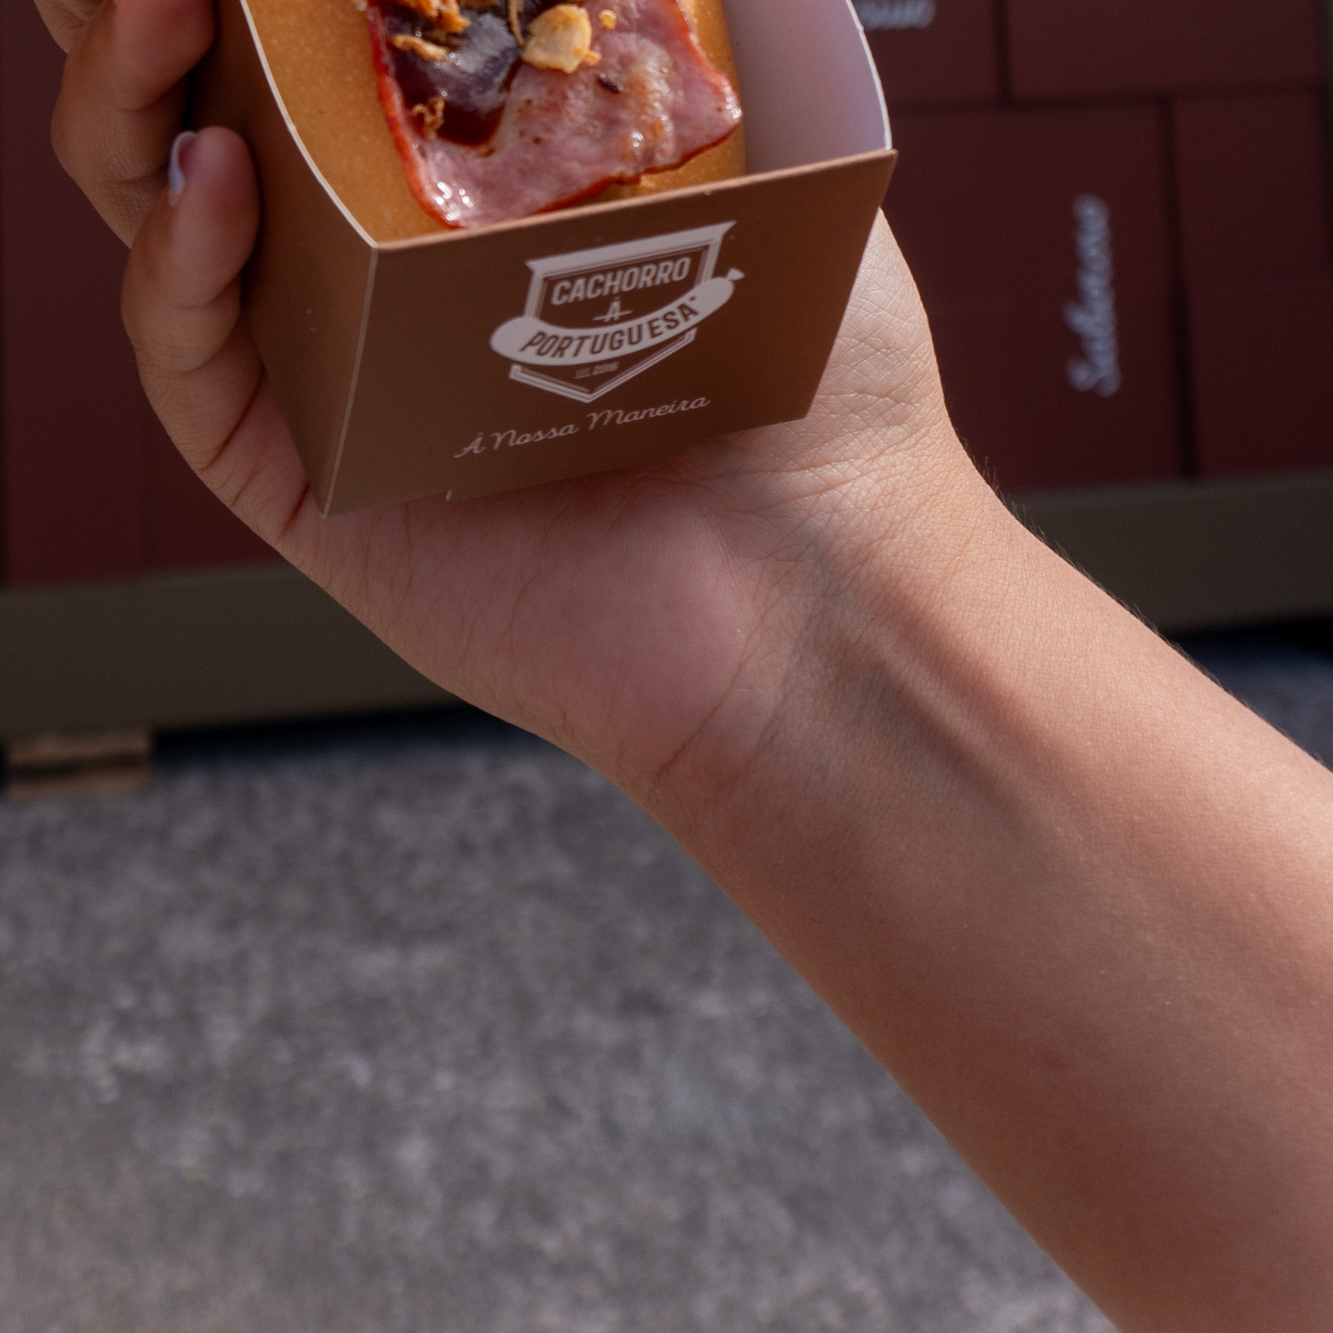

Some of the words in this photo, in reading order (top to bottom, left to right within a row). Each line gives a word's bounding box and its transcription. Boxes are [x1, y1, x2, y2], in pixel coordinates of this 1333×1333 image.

[550, 255, 692, 307] CACHORRO
[518, 300, 702, 360] PORTUGUESA
[489, 422, 581, 454] Nossa
[584, 394, 713, 434] Maneira
